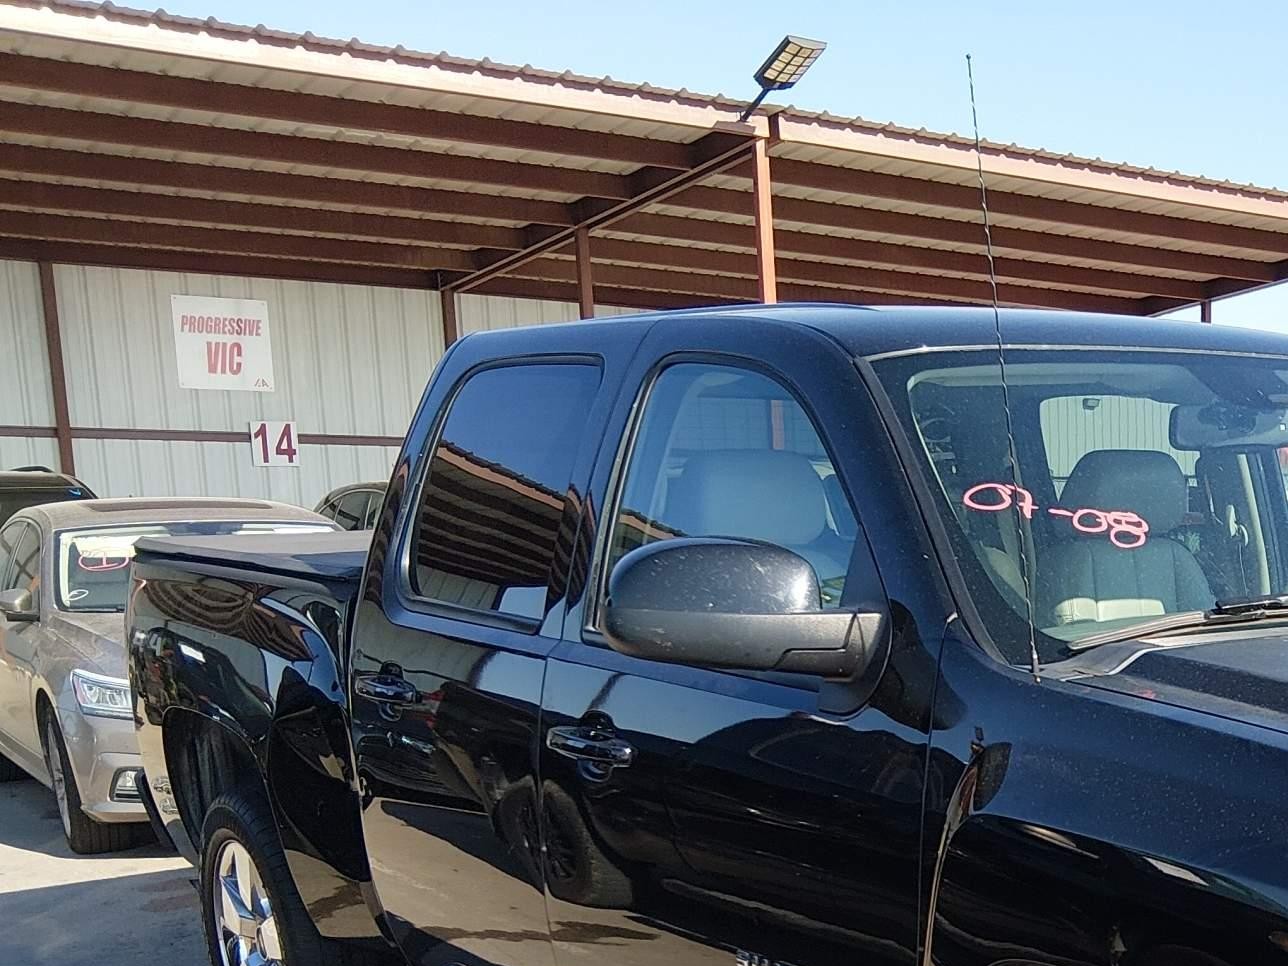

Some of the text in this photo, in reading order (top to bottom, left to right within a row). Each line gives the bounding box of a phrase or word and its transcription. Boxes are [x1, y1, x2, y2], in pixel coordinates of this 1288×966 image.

[180, 315, 262, 337] PROGRESSIVE
[206, 341, 242, 375] VIC
[253, 423, 297, 463] 14
